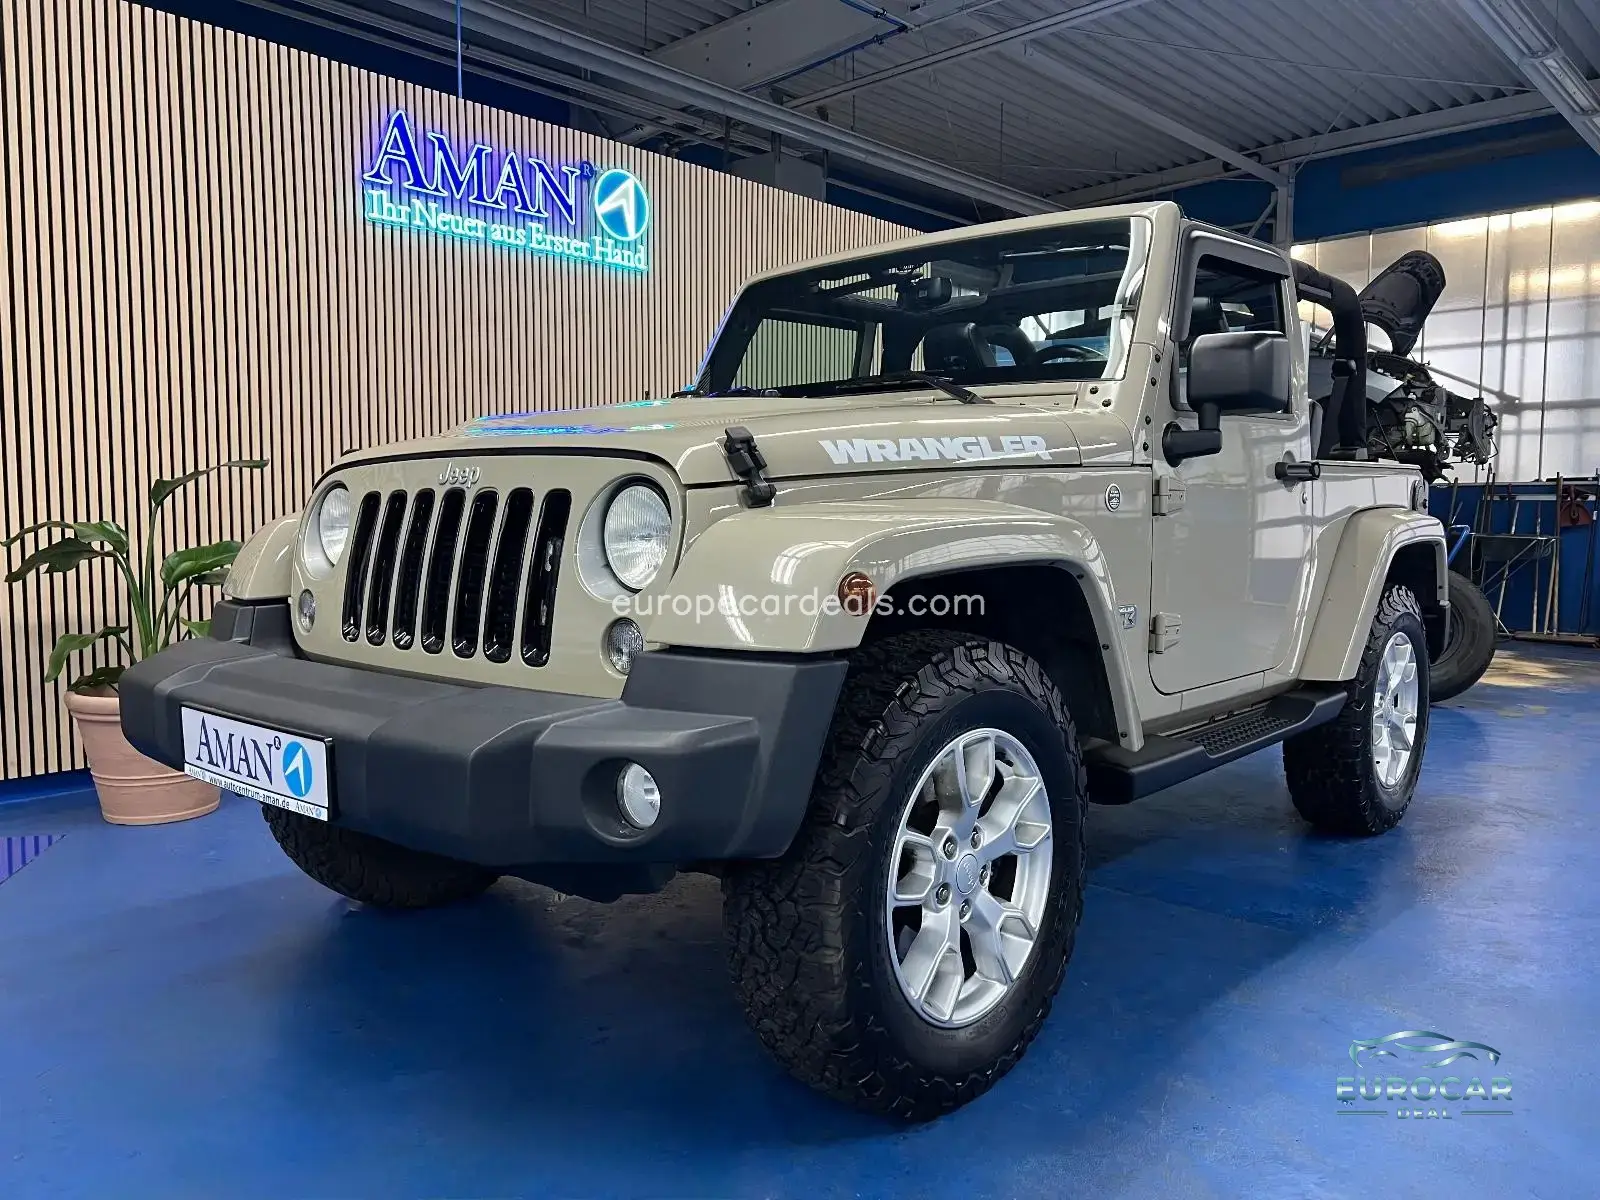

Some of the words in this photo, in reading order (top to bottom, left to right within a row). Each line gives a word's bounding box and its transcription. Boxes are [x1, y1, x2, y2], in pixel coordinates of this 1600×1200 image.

[367, 189, 411, 223] Ihr
[411, 198, 487, 238] Neuer
[490, 222, 527, 246] aus
[528, 221, 590, 258] Erster
[591, 234, 649, 271] Hand
[818, 435, 1053, 465] WRANGLER
[438, 461, 481, 489] Jeep
[208, 776, 290, 810] www.autocentrum-aman.de
